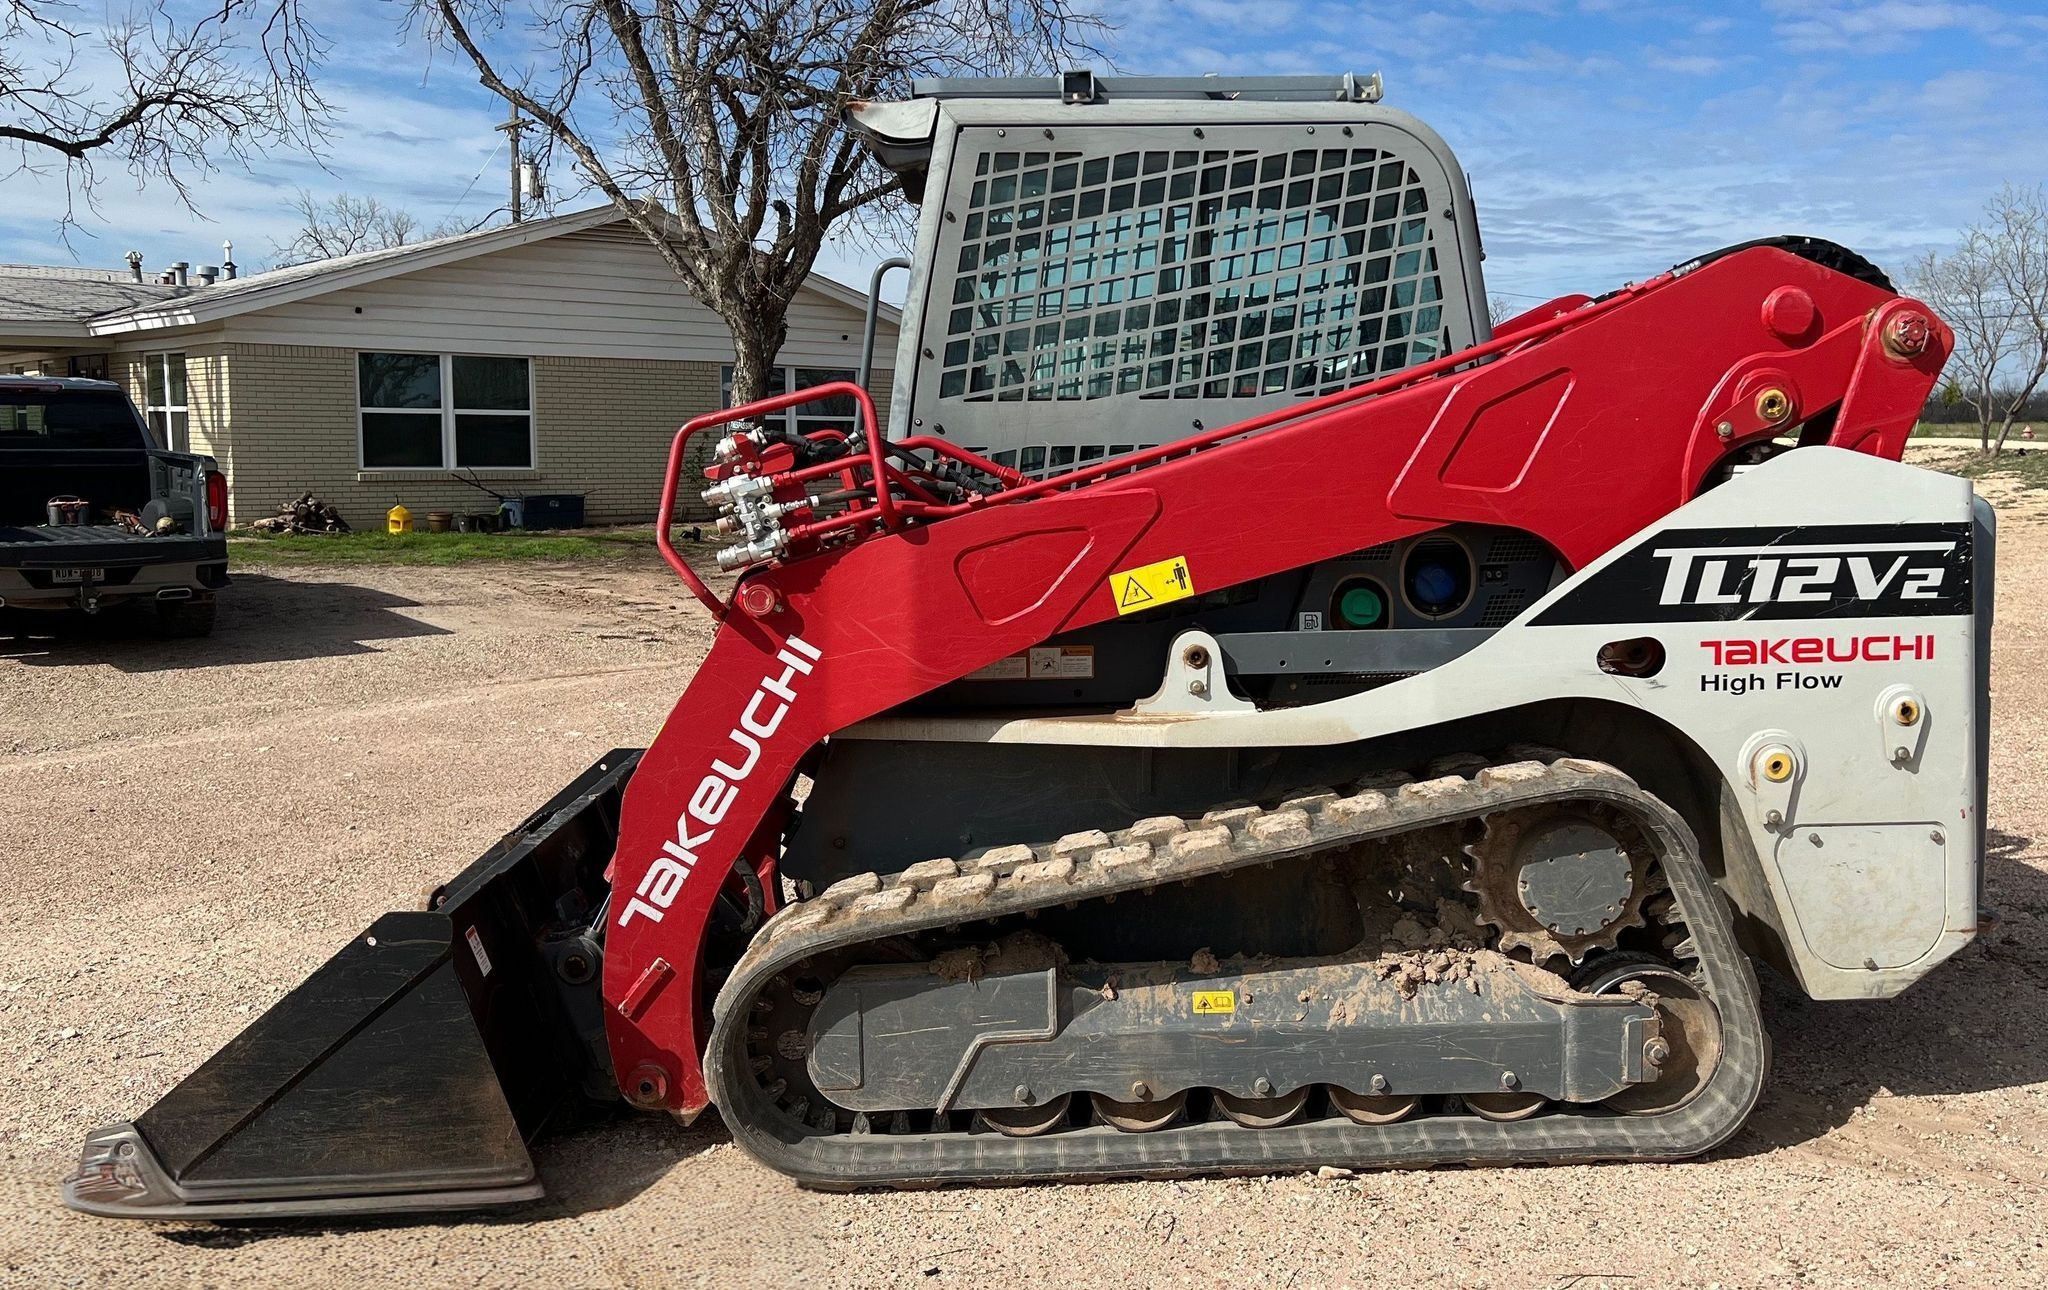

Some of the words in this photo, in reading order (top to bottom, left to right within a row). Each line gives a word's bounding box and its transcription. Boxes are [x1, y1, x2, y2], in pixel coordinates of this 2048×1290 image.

[1653, 541, 1956, 606] TL12V2
[1700, 635, 1935, 666] TAKEUCHI
[1700, 673, 1765, 695] High
[1776, 672, 1843, 690] Flow
[618, 634, 823, 927] TAKEUCHI
